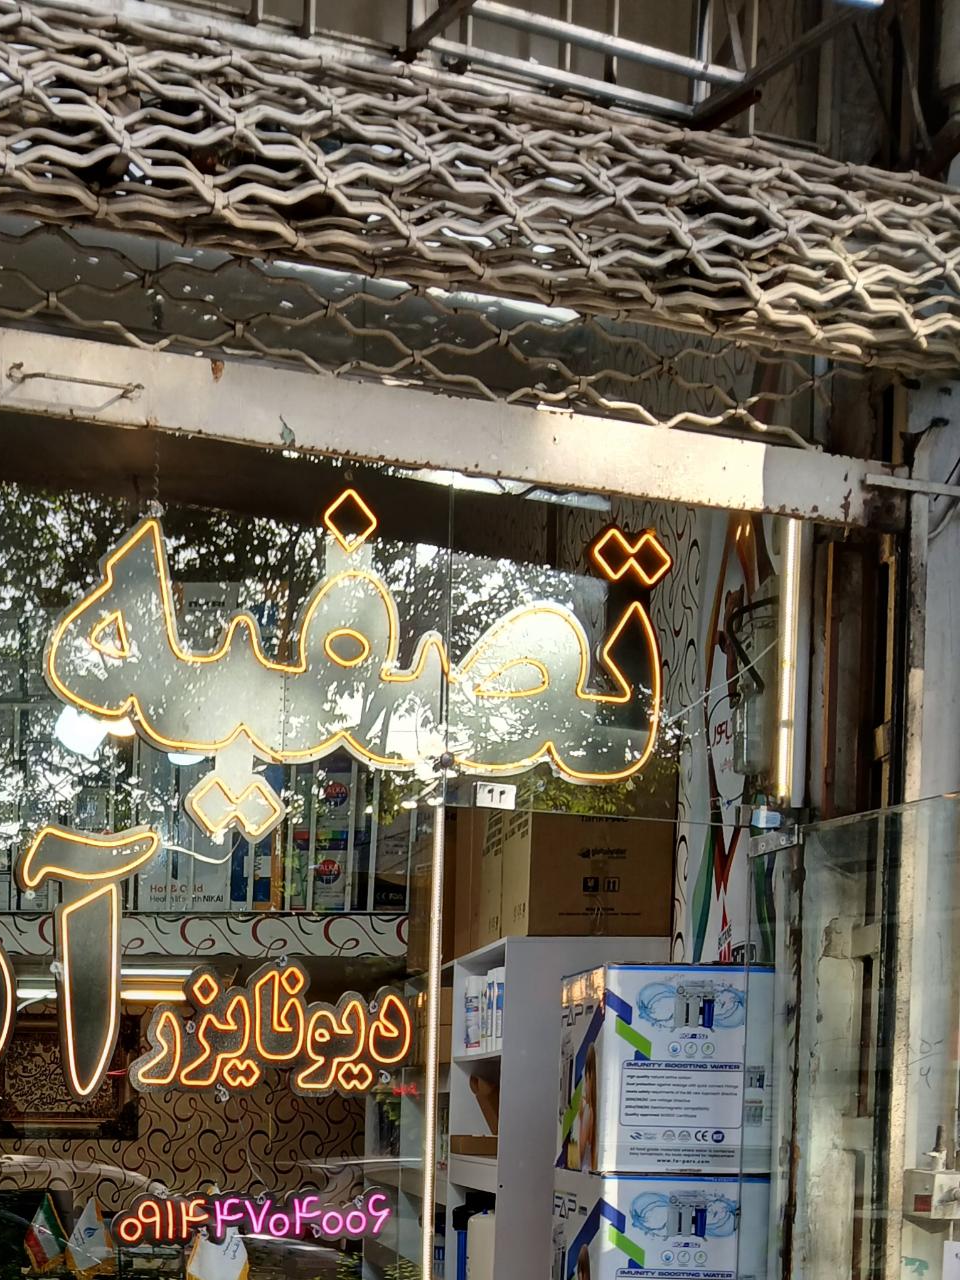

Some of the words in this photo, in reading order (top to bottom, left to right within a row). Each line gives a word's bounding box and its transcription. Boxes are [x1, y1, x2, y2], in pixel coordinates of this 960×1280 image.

[46, 488, 672, 841] تصفیه
[179, 884, 204, 893] Cld
[138, 965, 412, 1090] دیونایزر
